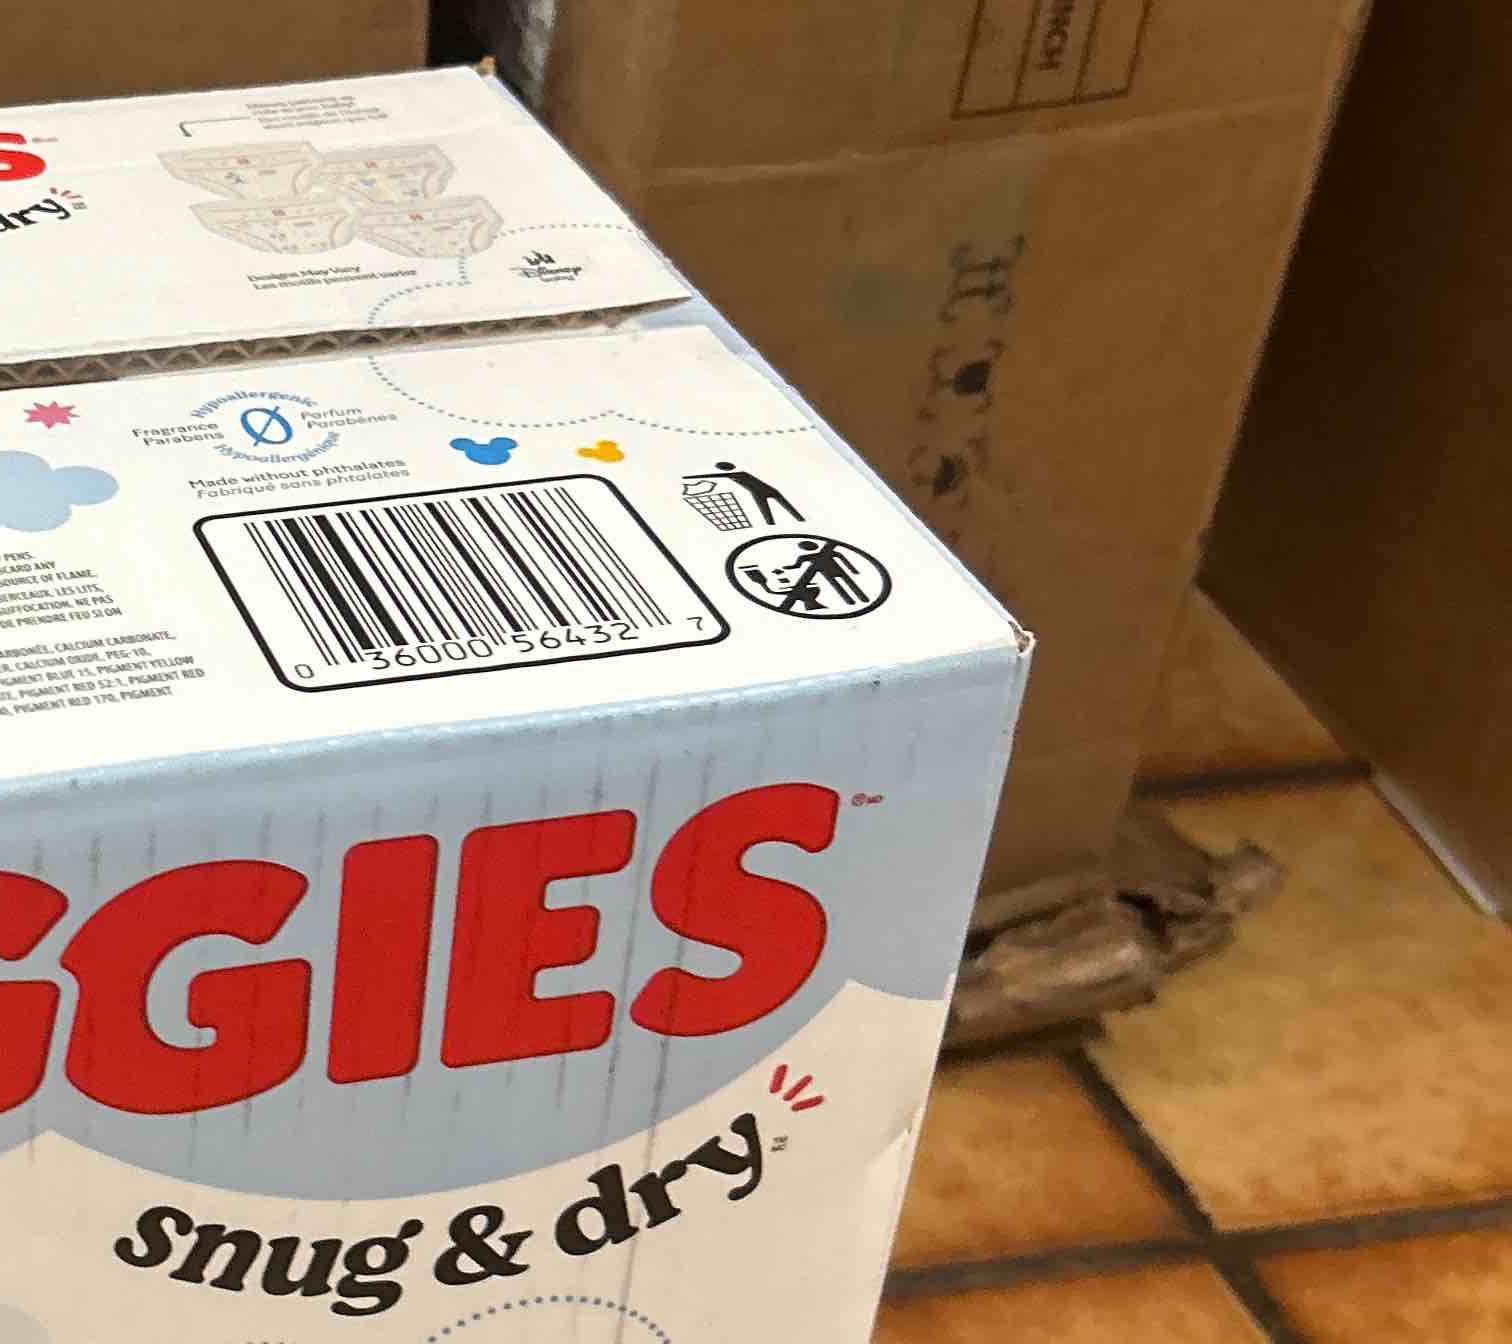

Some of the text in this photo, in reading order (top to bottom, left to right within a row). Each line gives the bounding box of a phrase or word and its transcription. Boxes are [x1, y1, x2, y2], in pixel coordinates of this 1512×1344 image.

[191, 391, 317, 418] Hypoallergenic
[300, 408, 363, 421] Parfum
[132, 422, 219, 438] Fragrance
[143, 431, 224, 446] Parabens
[189, 459, 406, 490] Made without phthalates
[197, 482, 276, 499] Fabriqué
[280, 478, 322, 490] sans
[295, 617, 706, 680] 0 36000 56432 7
[114, 1112, 764, 1316] snug & dry
